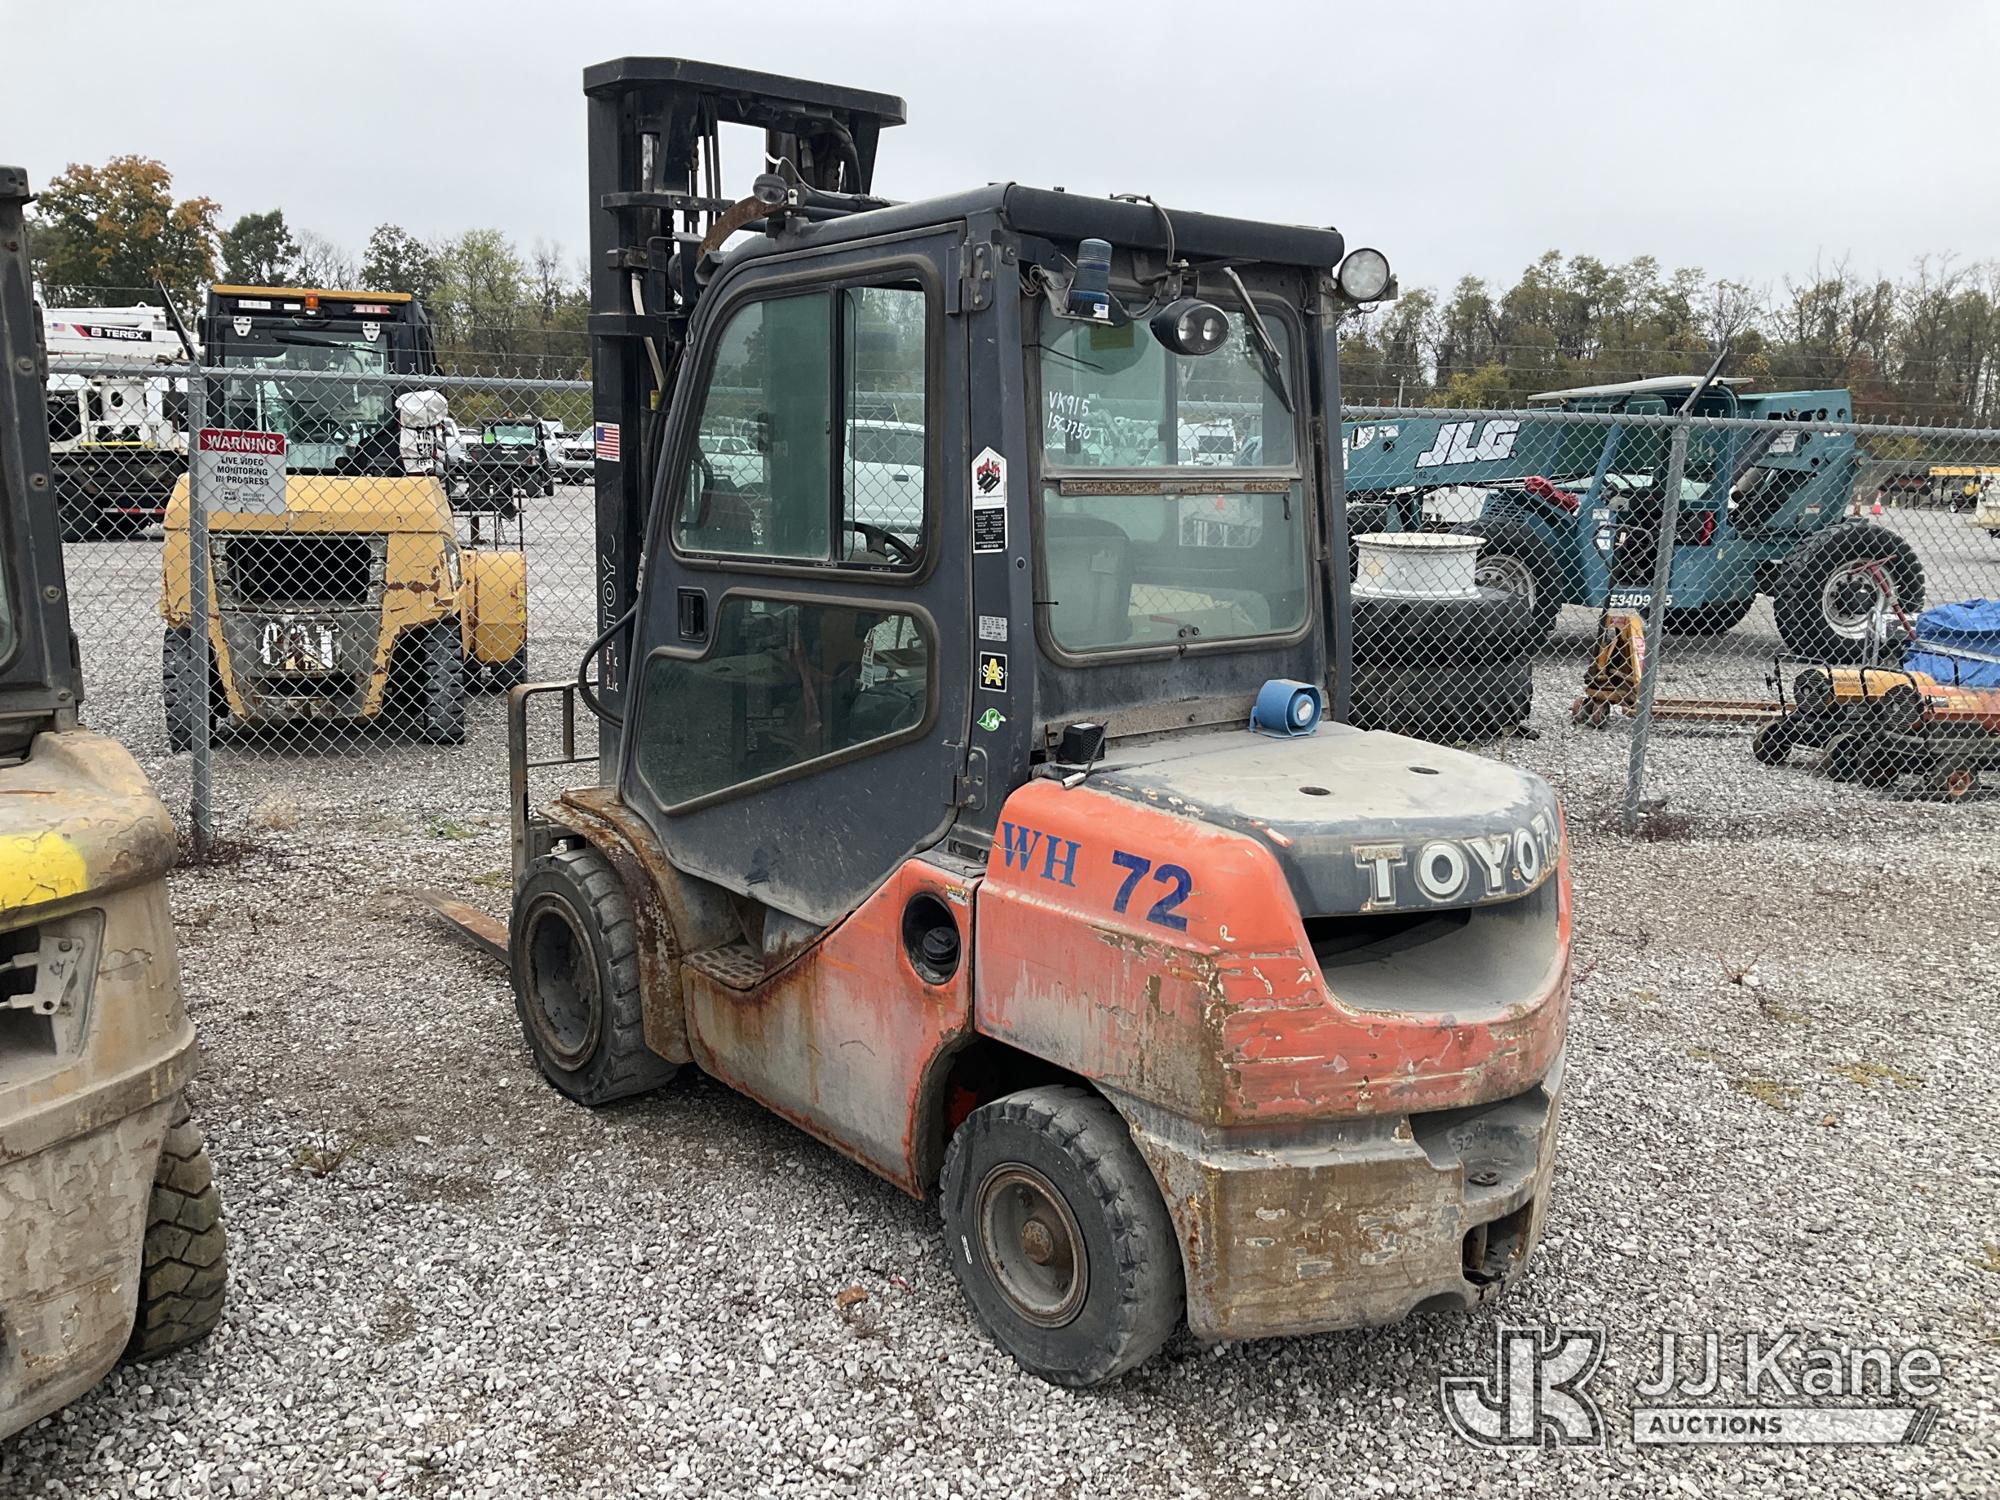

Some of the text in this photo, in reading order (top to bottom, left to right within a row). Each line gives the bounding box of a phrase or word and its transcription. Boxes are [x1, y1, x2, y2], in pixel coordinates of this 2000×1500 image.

[105, 328, 143, 340] TEREX
[1049, 391, 1091, 417] VK915
[207, 434, 277, 452] WARNING
[1414, 419, 1522, 469] JLG
[221, 456, 238, 465] LIVE
[217, 466, 268, 476] MONITORING
[215, 475, 269, 486] IN PROGRESS
[1609, 594, 1674, 608] 534D95
[1002, 821, 1192, 932] WH 72
